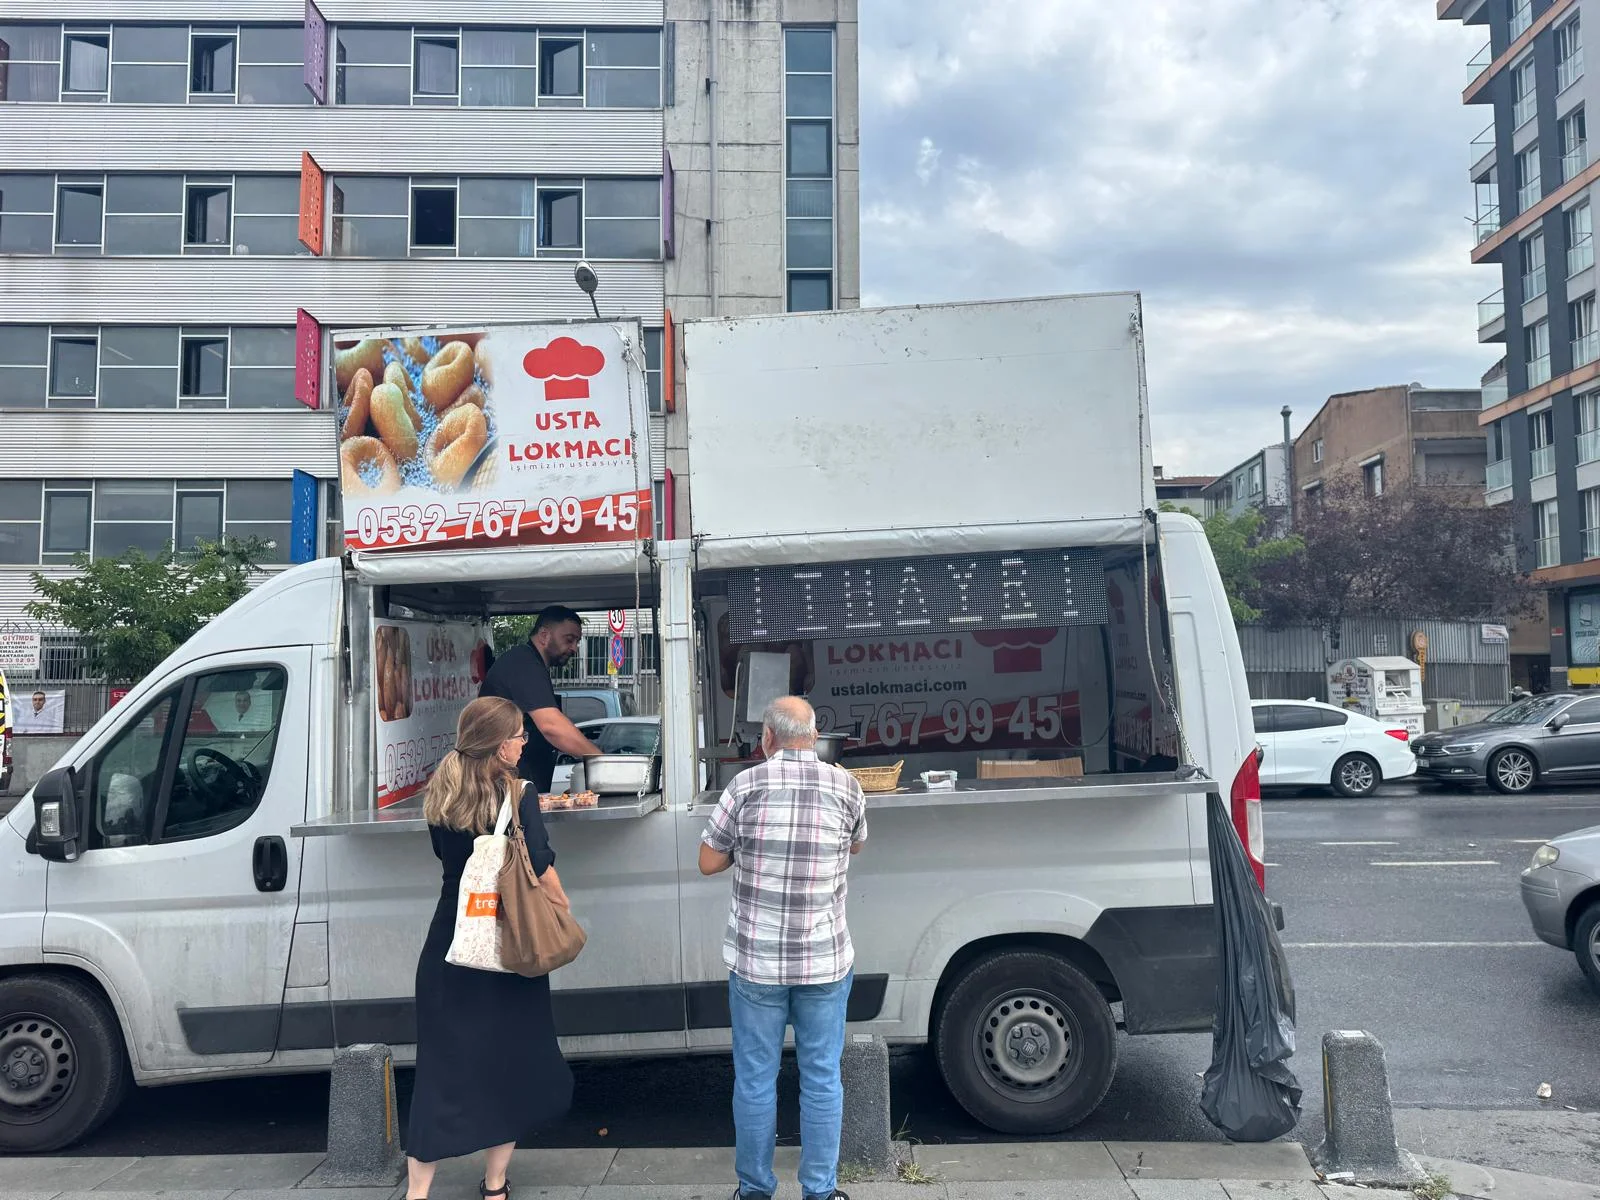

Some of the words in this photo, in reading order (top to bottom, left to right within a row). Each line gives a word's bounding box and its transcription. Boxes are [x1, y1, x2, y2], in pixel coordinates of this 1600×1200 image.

[535, 411, 601, 431] USTA
[508, 438, 631, 462] LOKMACI
[510, 462, 565, 472] işimizin
[357, 503, 448, 545] 0532
[457, 499, 526, 540] 767
[538, 496, 583, 535] 99
[594, 494, 638, 532] 45
[611, 610, 623, 623] 30
[426, 635, 457, 662] USTA
[827, 639, 963, 665] LOKMACI
[831, 679, 967, 697] ustalokmaci.com
[850, 701, 928, 747] 767
[942, 697, 994, 744] 99
[1008, 695, 1061, 740] 45
[475, 897, 497, 910] tre
